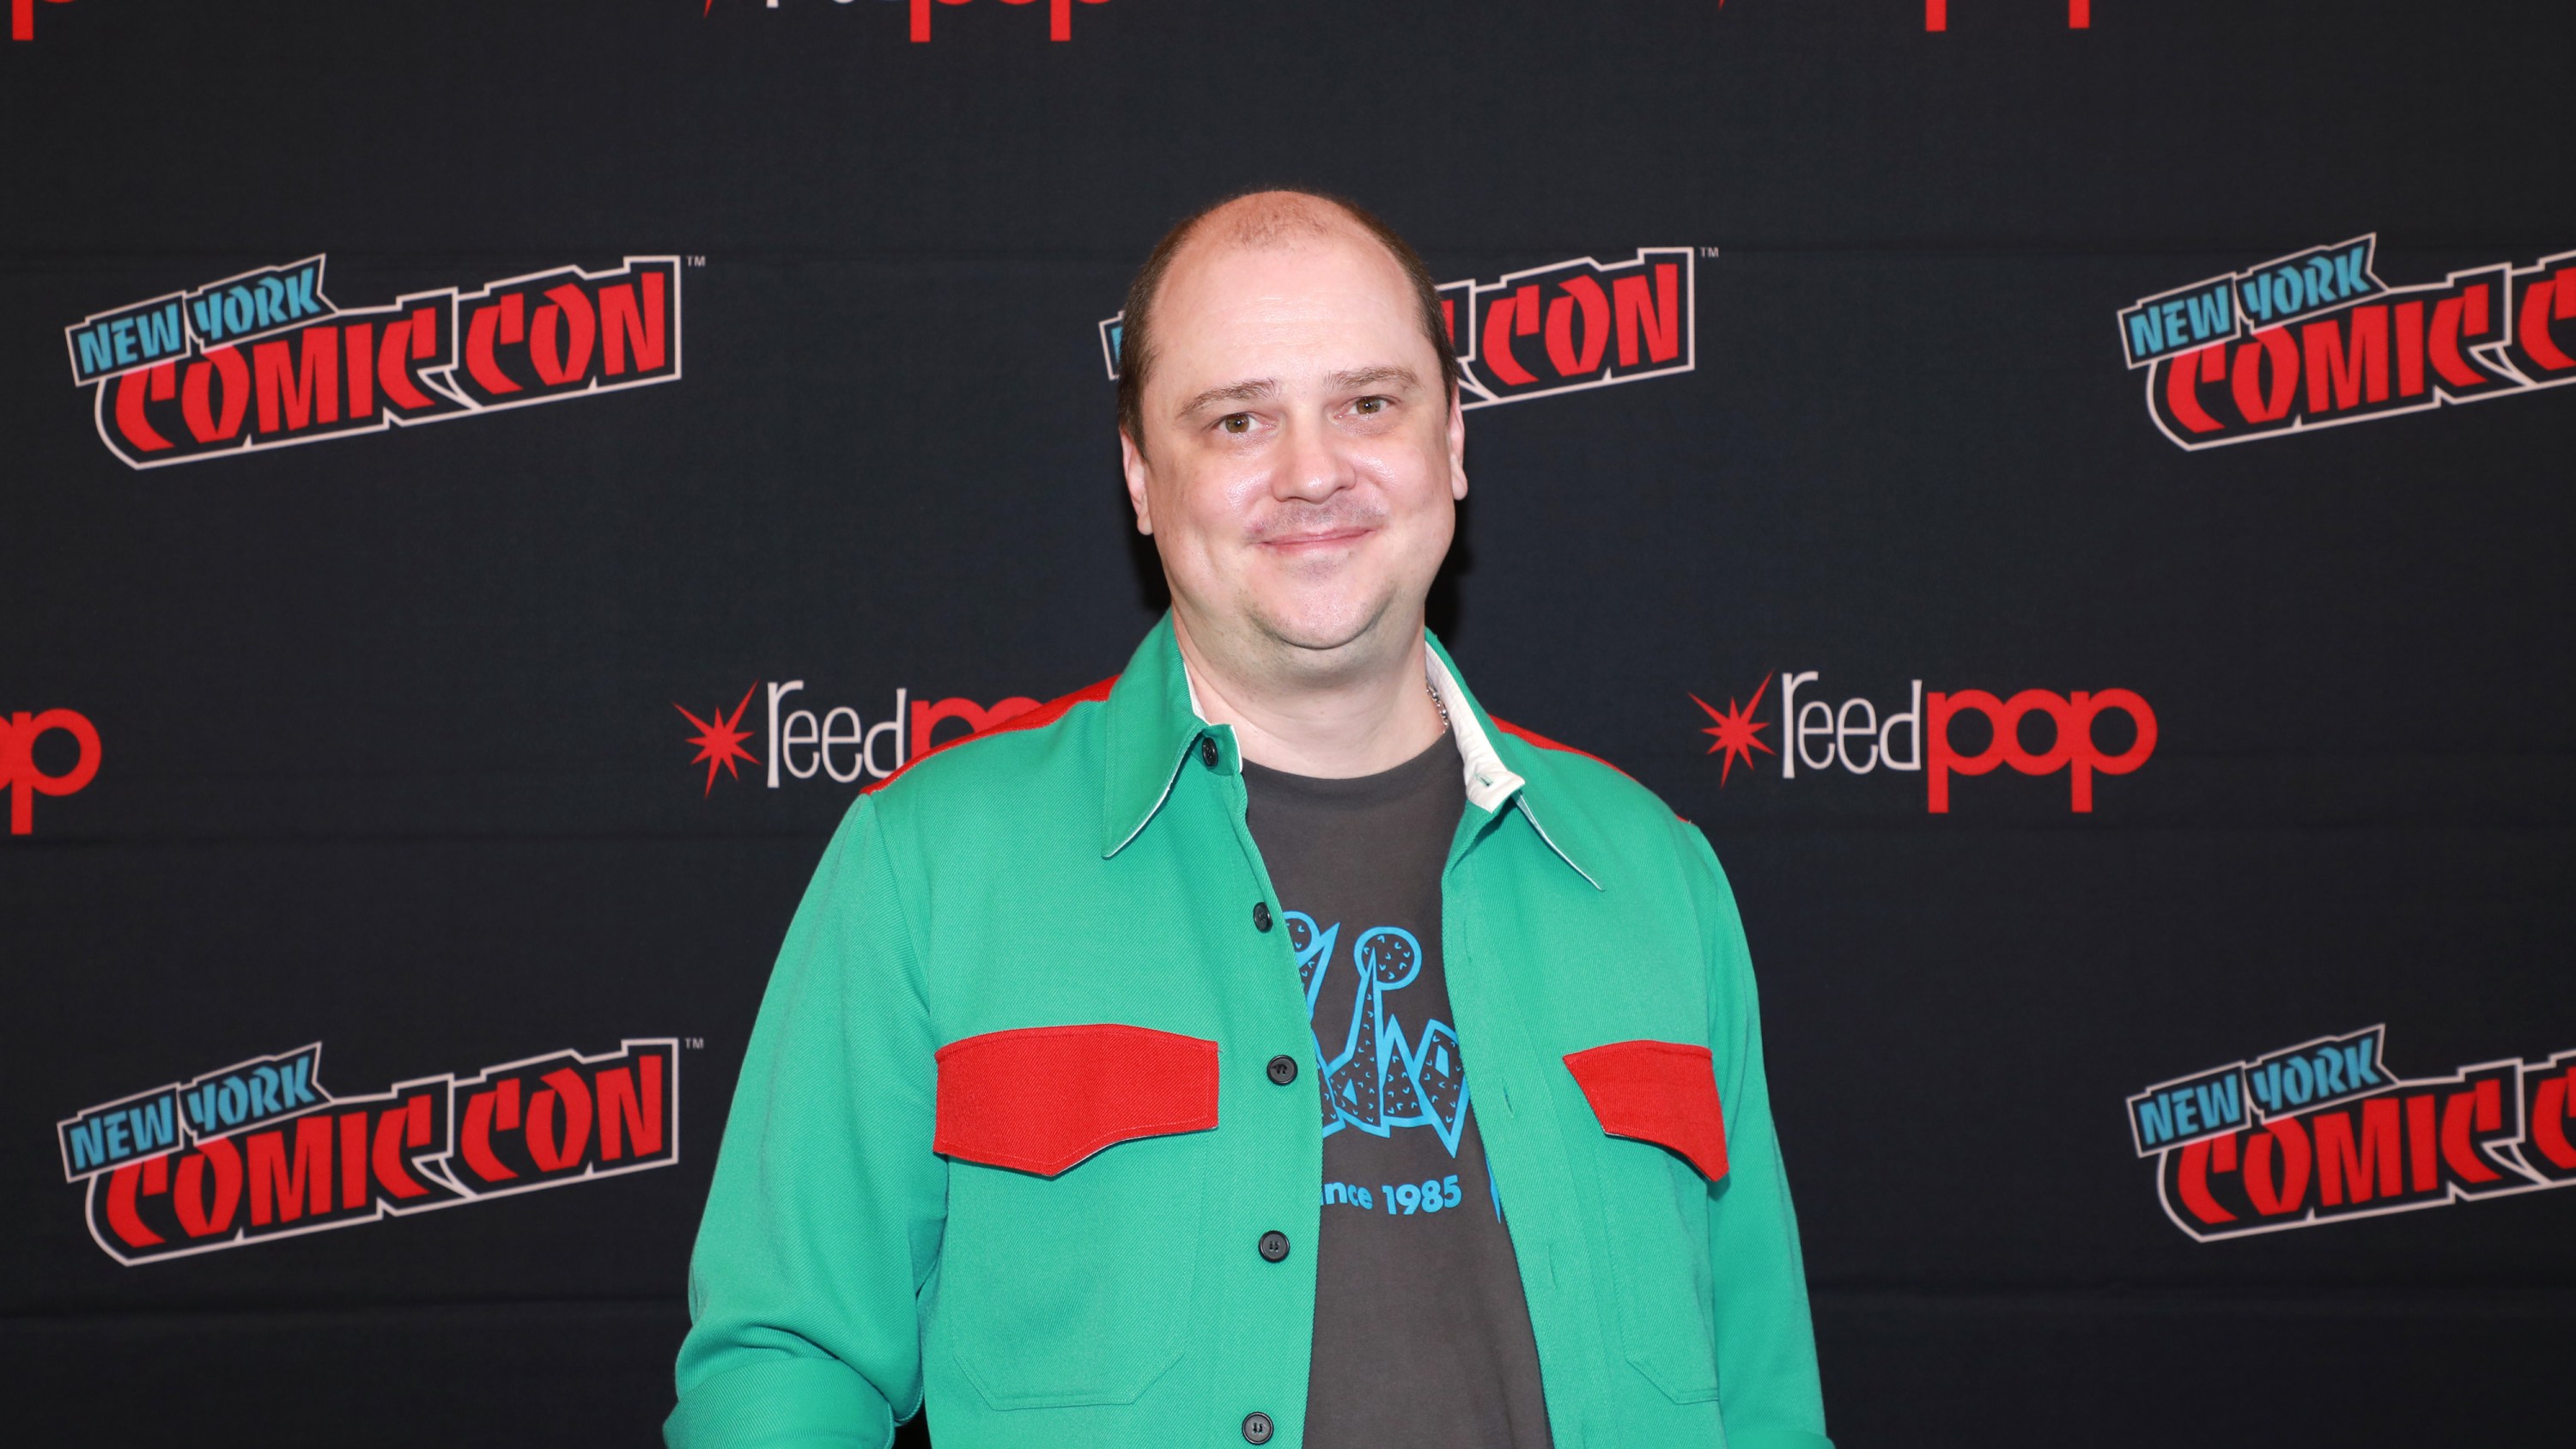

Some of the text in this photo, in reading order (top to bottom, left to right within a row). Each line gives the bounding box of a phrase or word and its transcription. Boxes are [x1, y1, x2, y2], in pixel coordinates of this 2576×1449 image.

[79, 268, 320, 374] NEW YORK
[1481, 263, 1679, 387] CON
[2129, 247, 2370, 356] NEW YORK
[115, 271, 665, 452] COMIC CON
[2166, 283, 2489, 434] COMIC
[767, 679, 1043, 788] reed
[70, 1056, 315, 1169] NEW YORK
[2139, 1038, 2381, 1144] NEW YORK
[106, 1055, 663, 1248] COMIC CON
[1381, 1174, 1462, 1215] 1985
[2178, 1079, 2502, 1225] COMIC
